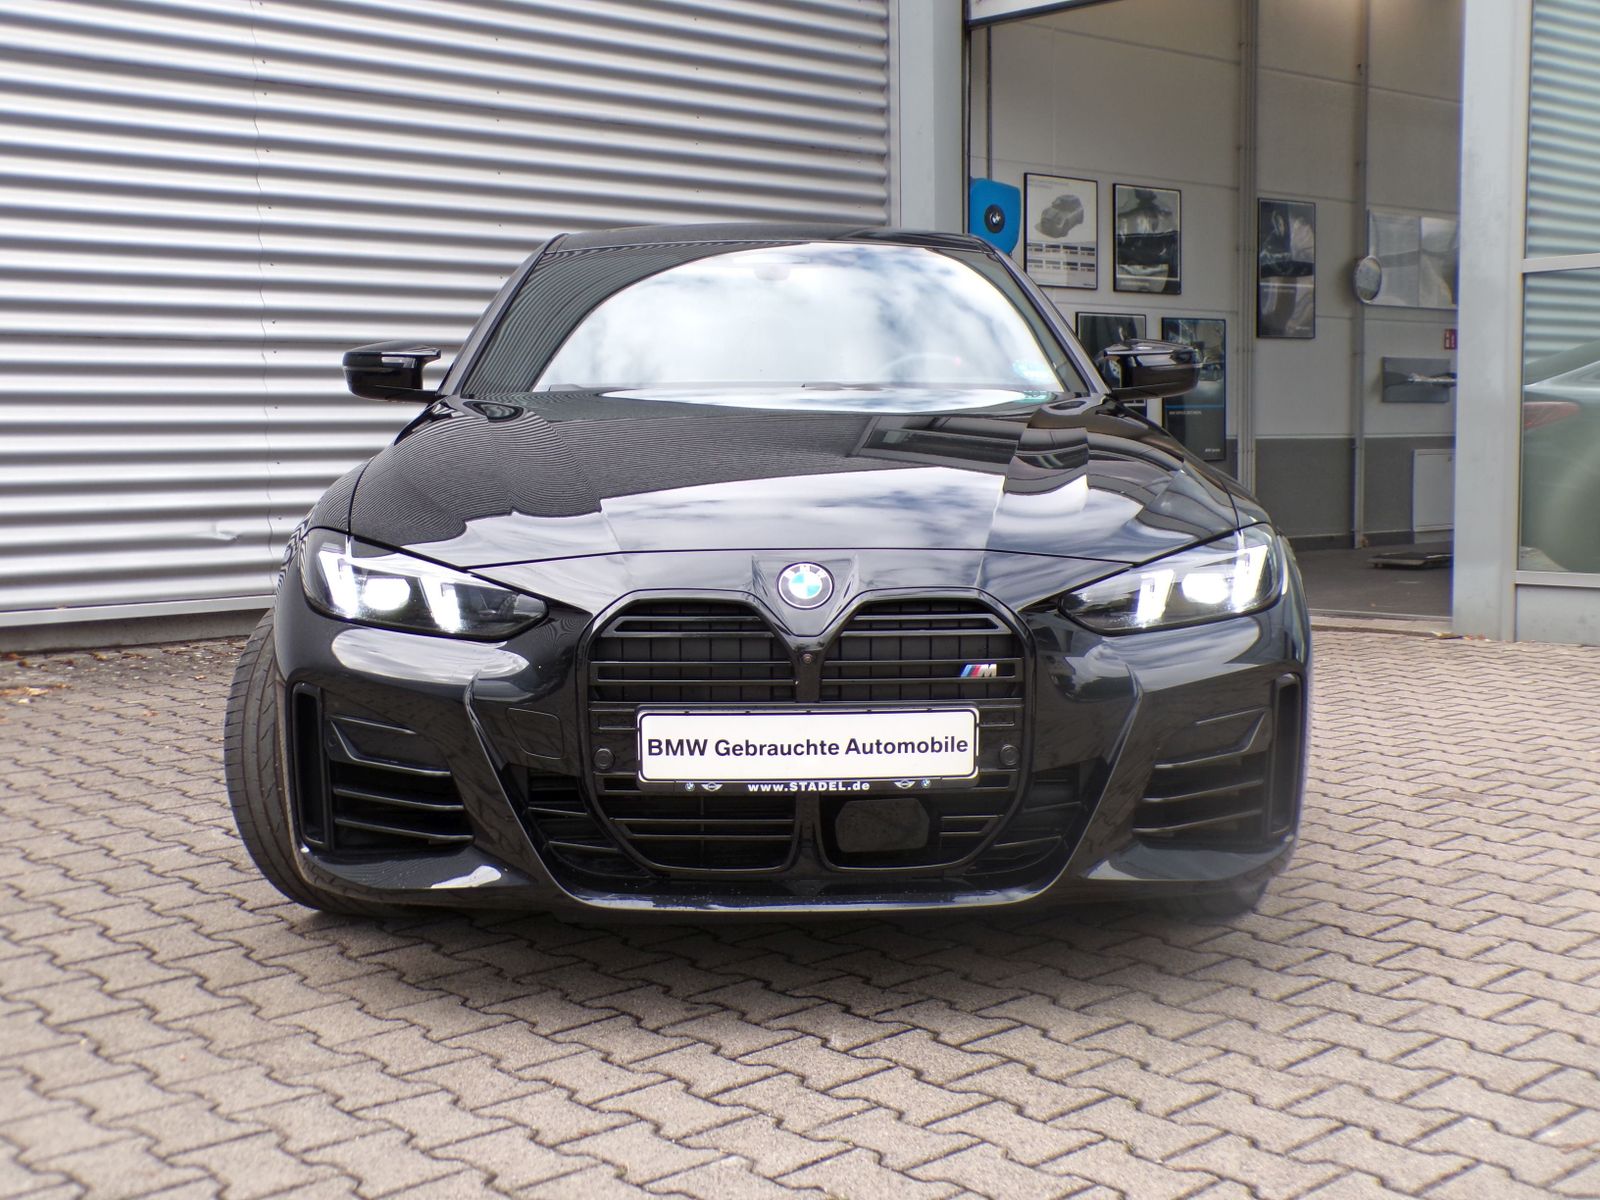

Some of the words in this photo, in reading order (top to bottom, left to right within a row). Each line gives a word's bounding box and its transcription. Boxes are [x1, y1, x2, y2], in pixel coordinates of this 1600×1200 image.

[977, 663, 998, 679] M
[647, 738, 708, 757] BMW
[714, 737, 840, 757] Gebrauchte
[845, 736, 969, 755] Automobile
[747, 781, 871, 792] www.STADEL.de
